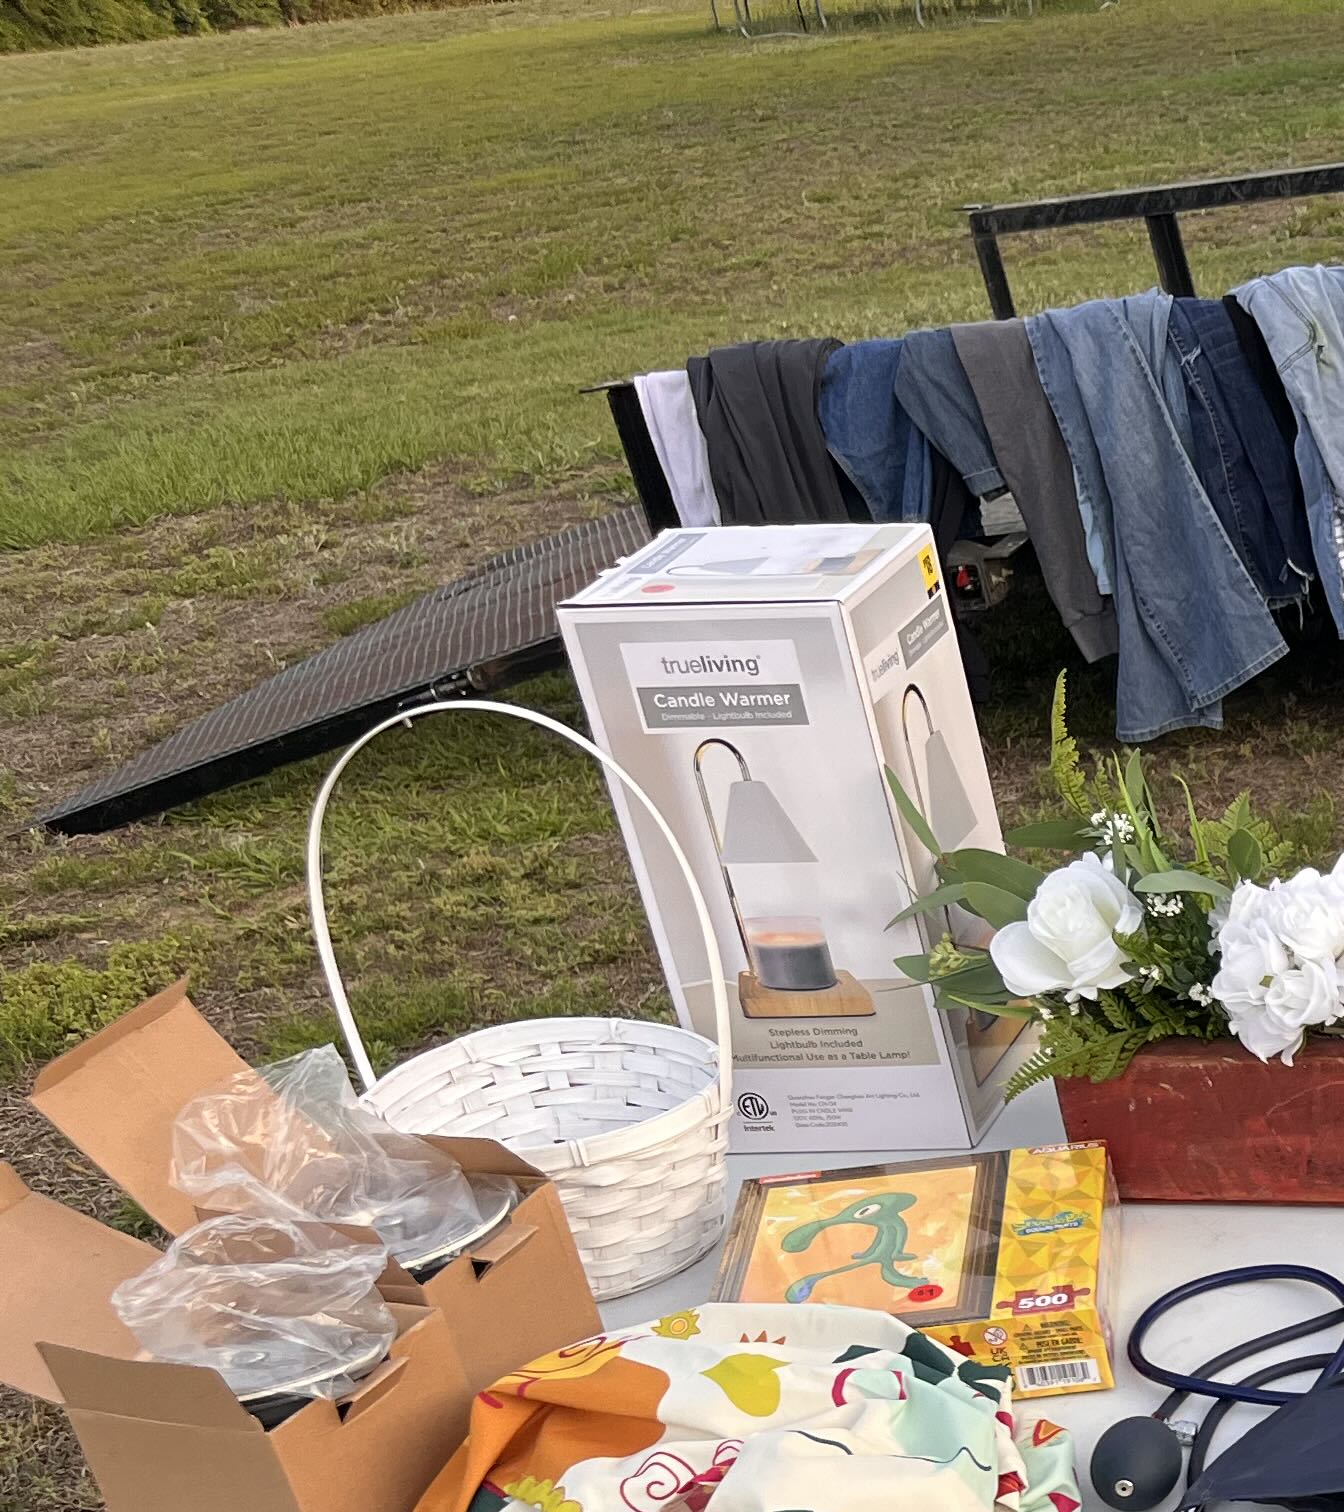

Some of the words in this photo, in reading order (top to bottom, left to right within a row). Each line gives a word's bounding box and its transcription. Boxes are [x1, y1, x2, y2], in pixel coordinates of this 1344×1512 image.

[661, 654, 760, 676] trueliving
[653, 692, 716, 709] Candle
[719, 692, 791, 707] Warmer
[768, 1028, 811, 1038] Stepless
[813, 1027, 859, 1037] Dimming
[769, 1041, 818, 1051] Lightbulb
[820, 1039, 864, 1049] Included
[807, 1053, 825, 1062] Use
[849, 1051, 877, 1061] Table
[879, 1050, 912, 1061] Lamp!
[743, 1124, 775, 1132] Intertek
[1032, 1142, 1100, 1155] AQUARIUS
[1018, 1293, 1068, 1308] 500
